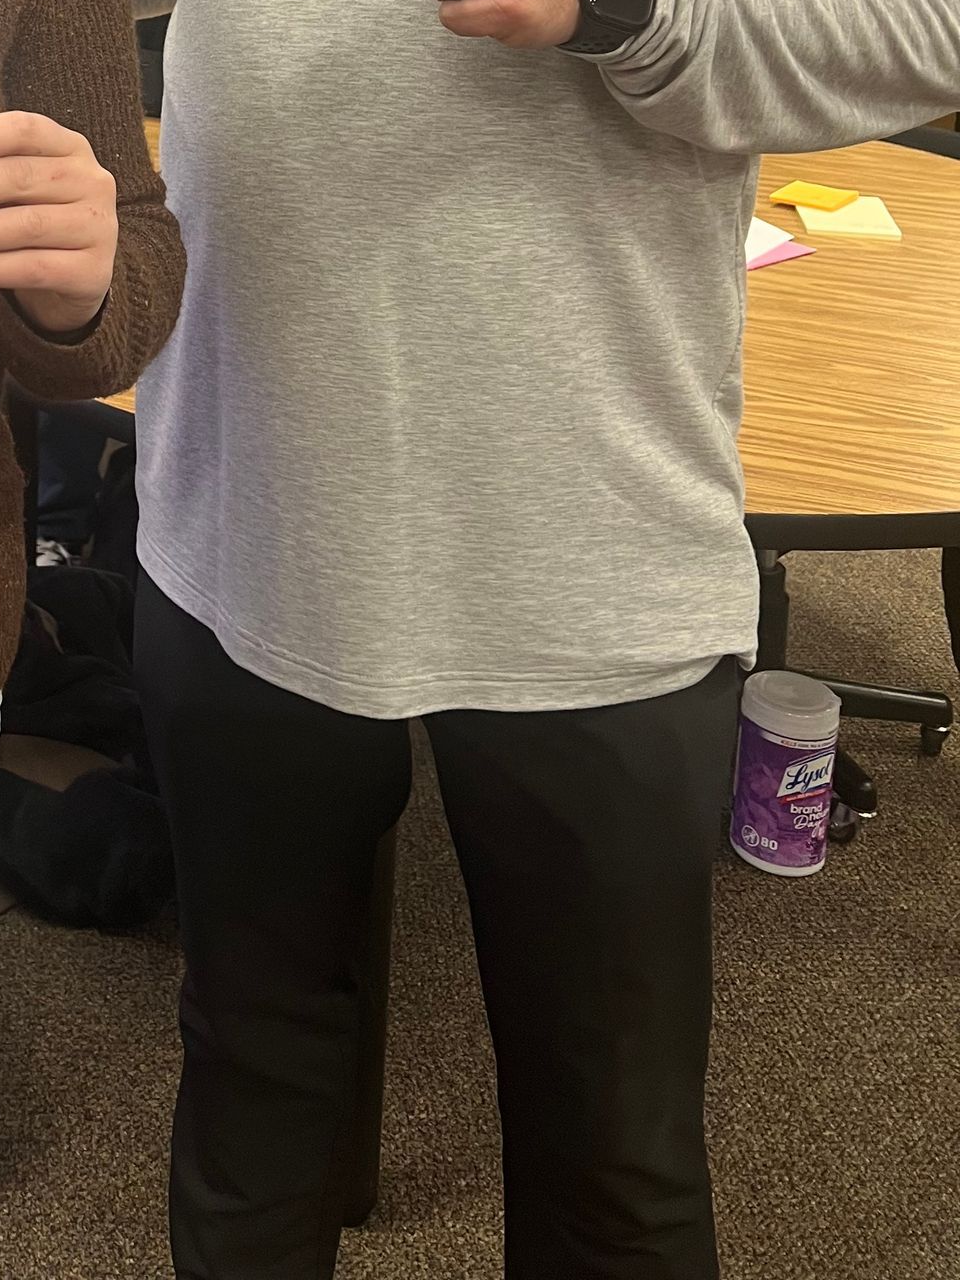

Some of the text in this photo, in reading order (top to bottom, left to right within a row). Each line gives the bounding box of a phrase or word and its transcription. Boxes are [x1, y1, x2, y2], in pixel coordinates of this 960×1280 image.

[785, 754, 832, 793] Lysol
[791, 801, 823, 814] brand
[761, 836, 778, 851] 80
